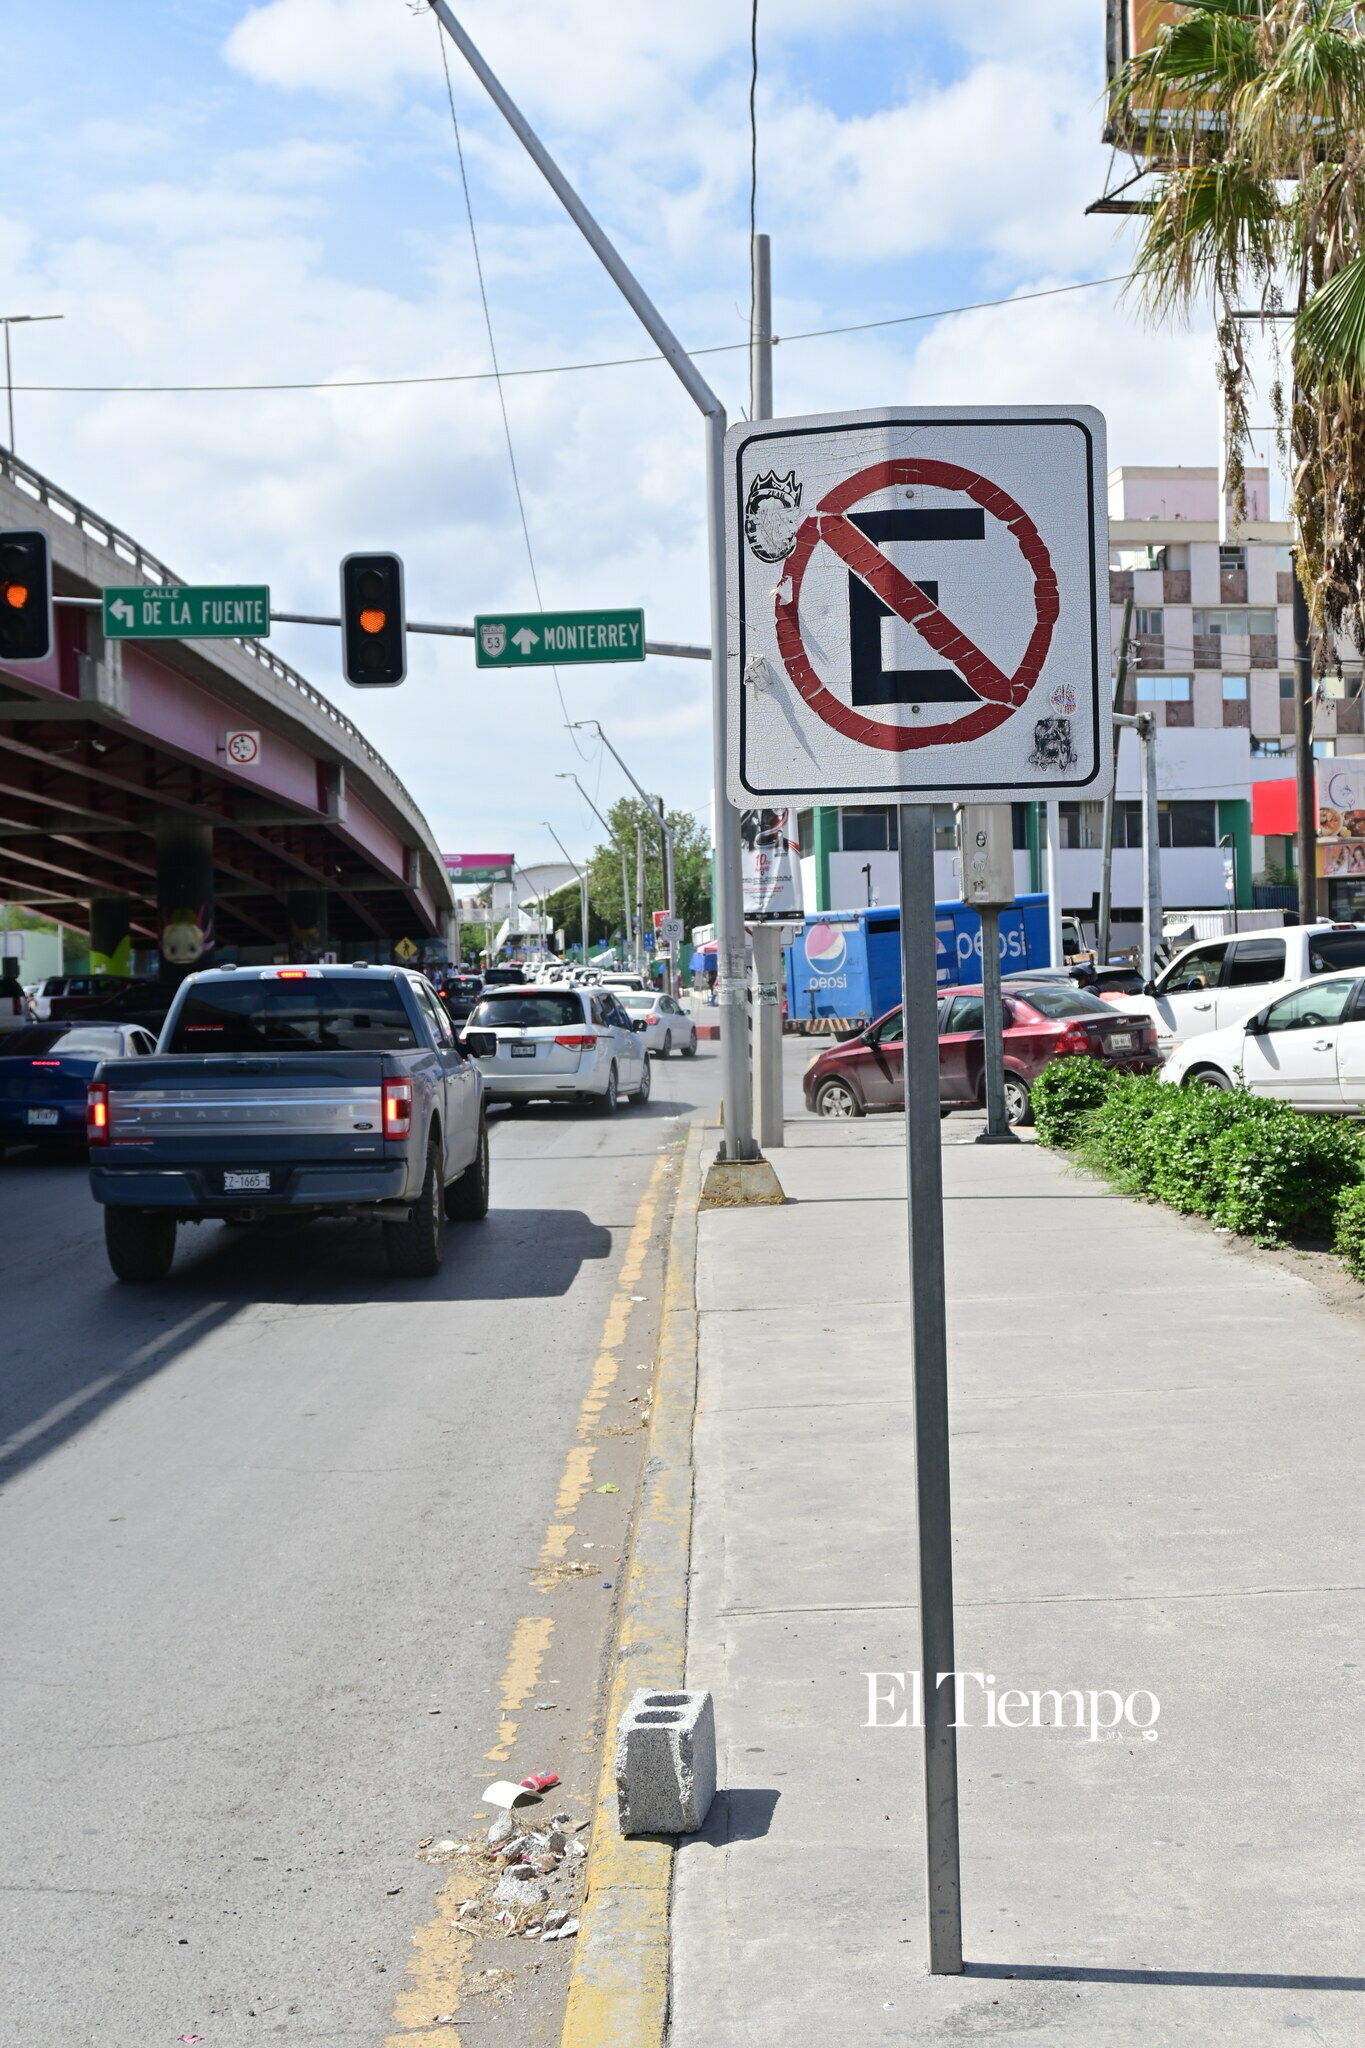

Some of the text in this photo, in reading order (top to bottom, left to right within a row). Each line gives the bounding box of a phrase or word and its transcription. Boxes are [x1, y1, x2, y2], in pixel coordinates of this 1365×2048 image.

[142, 589, 179, 598] CALLE
[142, 600, 263, 625] DE LA FUENTE
[848, 507, 985, 707] E
[487, 637, 500, 649] 53
[544, 623, 639, 650] MONTERREY
[809, 974, 847, 990] pepsi
[152, 1108, 338, 1120] PLATINUM
